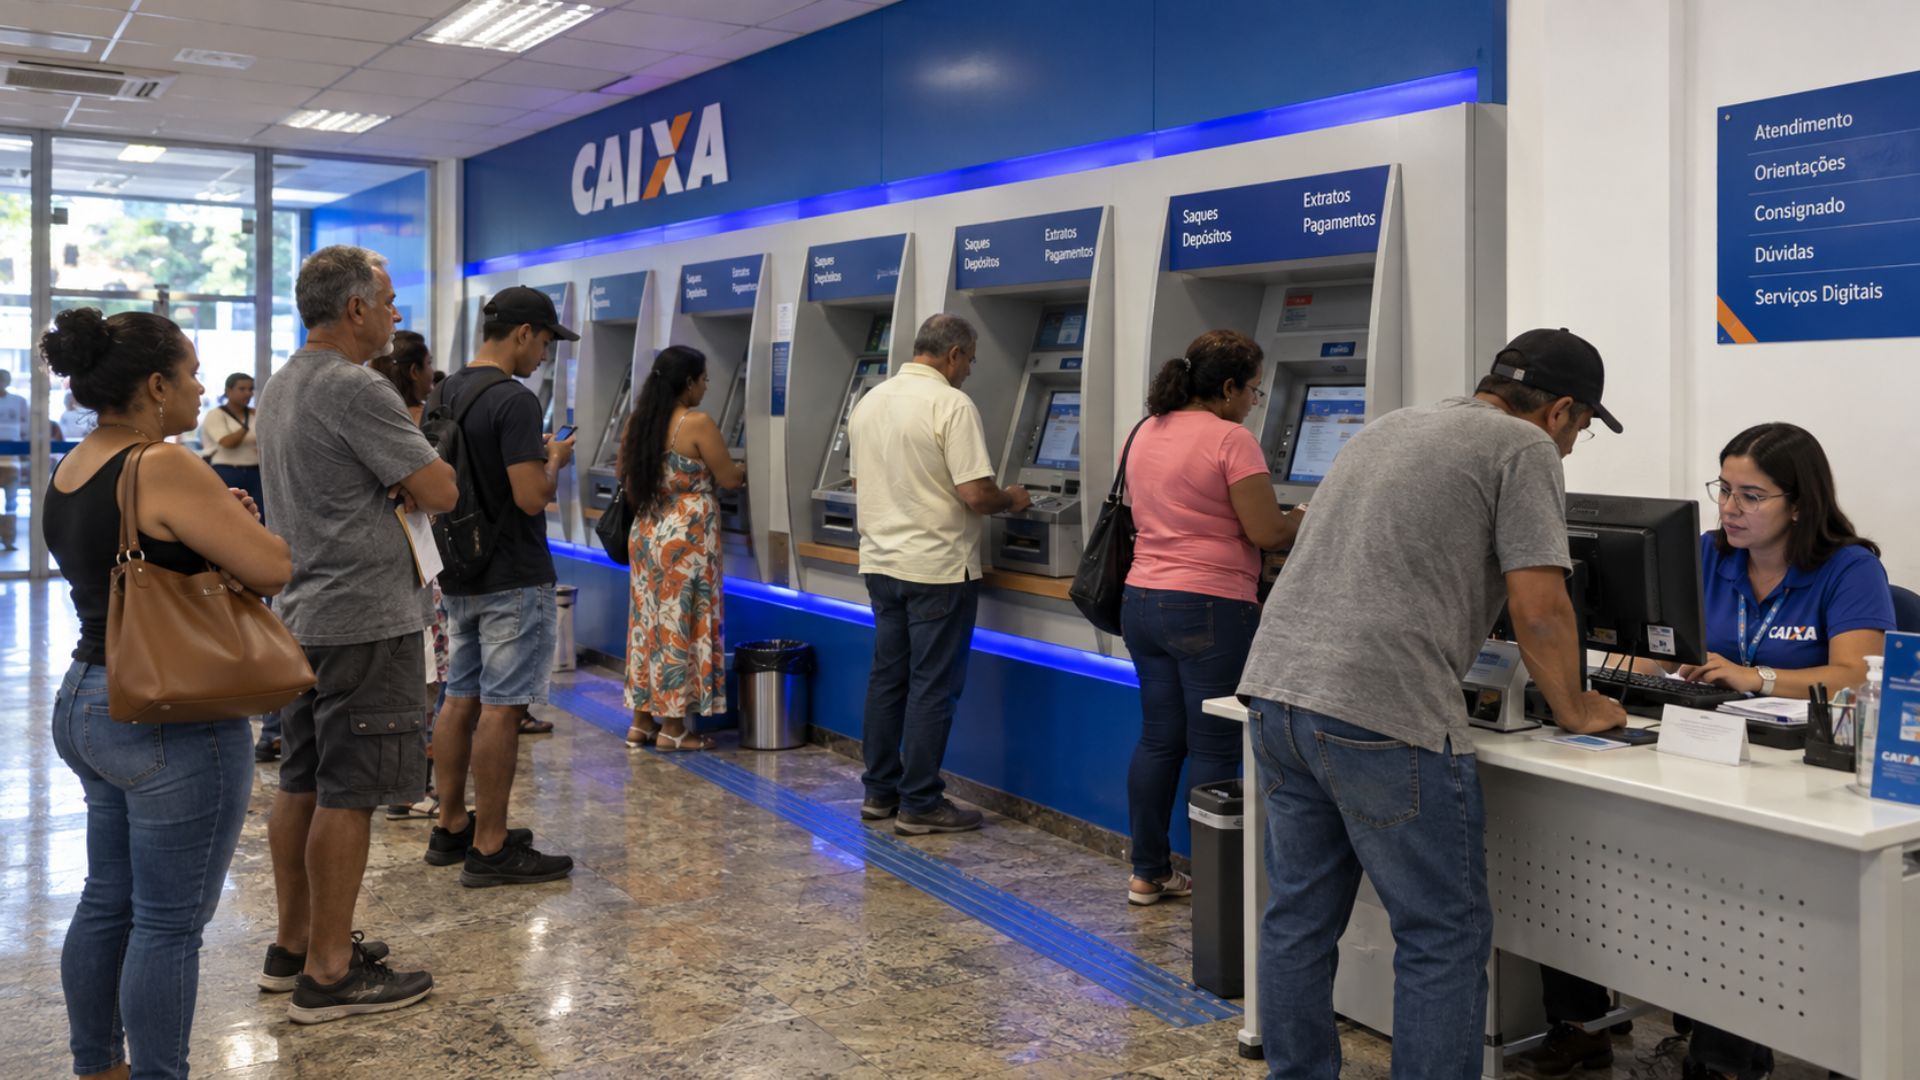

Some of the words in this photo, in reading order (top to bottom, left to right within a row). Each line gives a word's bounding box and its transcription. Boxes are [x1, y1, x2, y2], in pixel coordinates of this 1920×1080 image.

[1754, 113, 1853, 141] Atendimento
[571, 102, 728, 215] CAIXA
[1754, 156, 1846, 181] Orientações
[1303, 190, 1351, 208] Extratos
[1183, 207, 1218, 226] Saques
[1754, 197, 1845, 222] Consignado
[1303, 212, 1376, 236] Pagamentos
[1044, 227, 1077, 241] Extratos
[1182, 229, 1232, 249] Depósitos
[964, 238, 990, 253] Saques
[1044, 246, 1094, 264] Pagamentos
[1755, 244, 1814, 263] Dúvidas
[964, 256, 1000, 273] Depósitos
[1755, 289, 1817, 307] Serviços
[1822, 282, 1883, 305] Digitais
[1768, 626, 1818, 641] CAIXA
